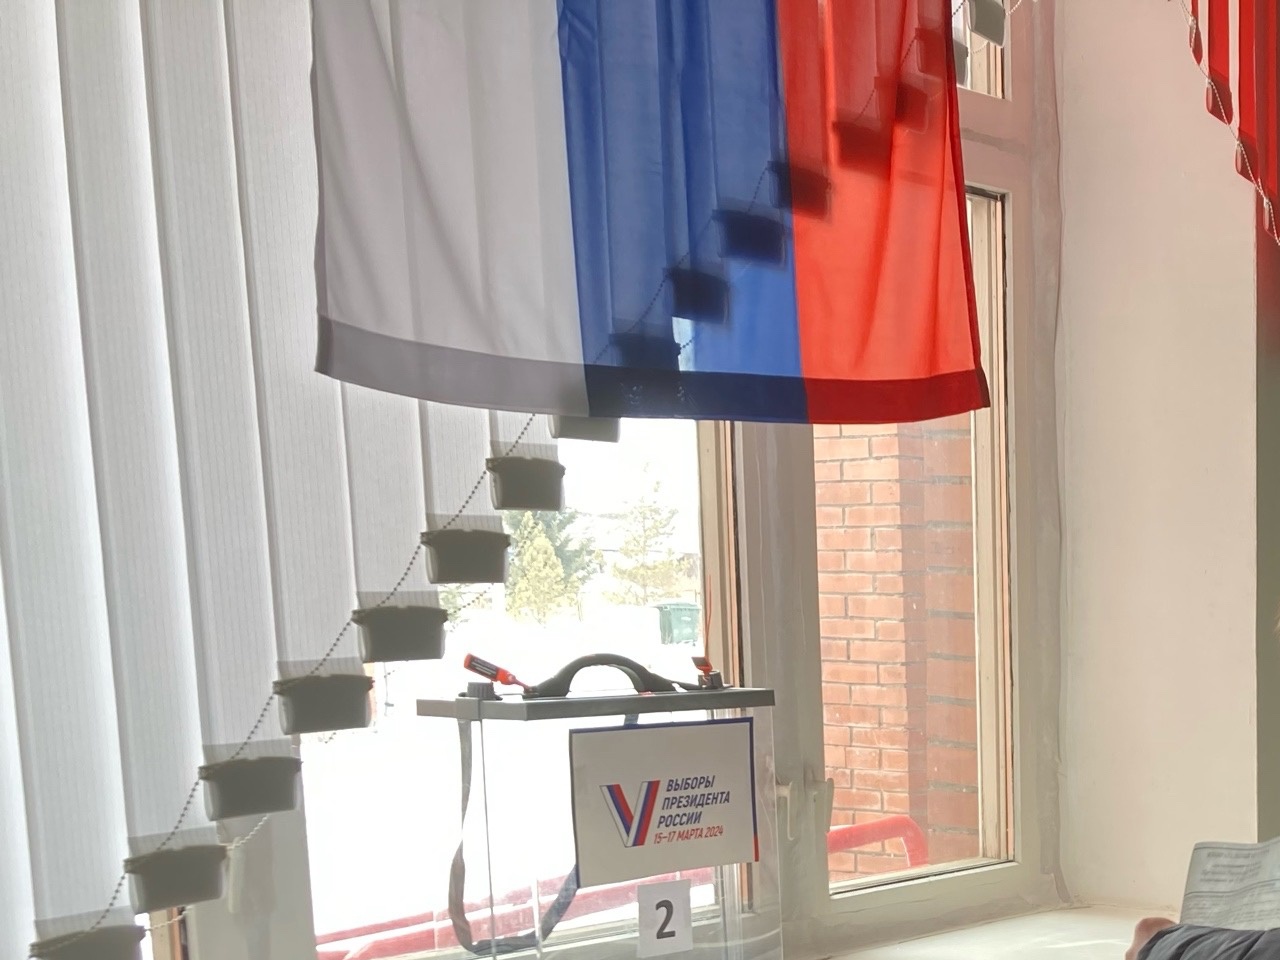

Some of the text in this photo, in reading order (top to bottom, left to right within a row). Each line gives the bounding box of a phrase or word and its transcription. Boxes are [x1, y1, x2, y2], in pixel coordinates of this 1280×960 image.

[666, 775, 715, 792] ВЫБОРЫ
[661, 791, 730, 811] ПРЕЗИДЕНТА
[657, 811, 702, 829] РОССИИ
[676, 828, 703, 842] МАРТА
[704, 825, 724, 838] 2024
[655, 899, 676, 940] 2
